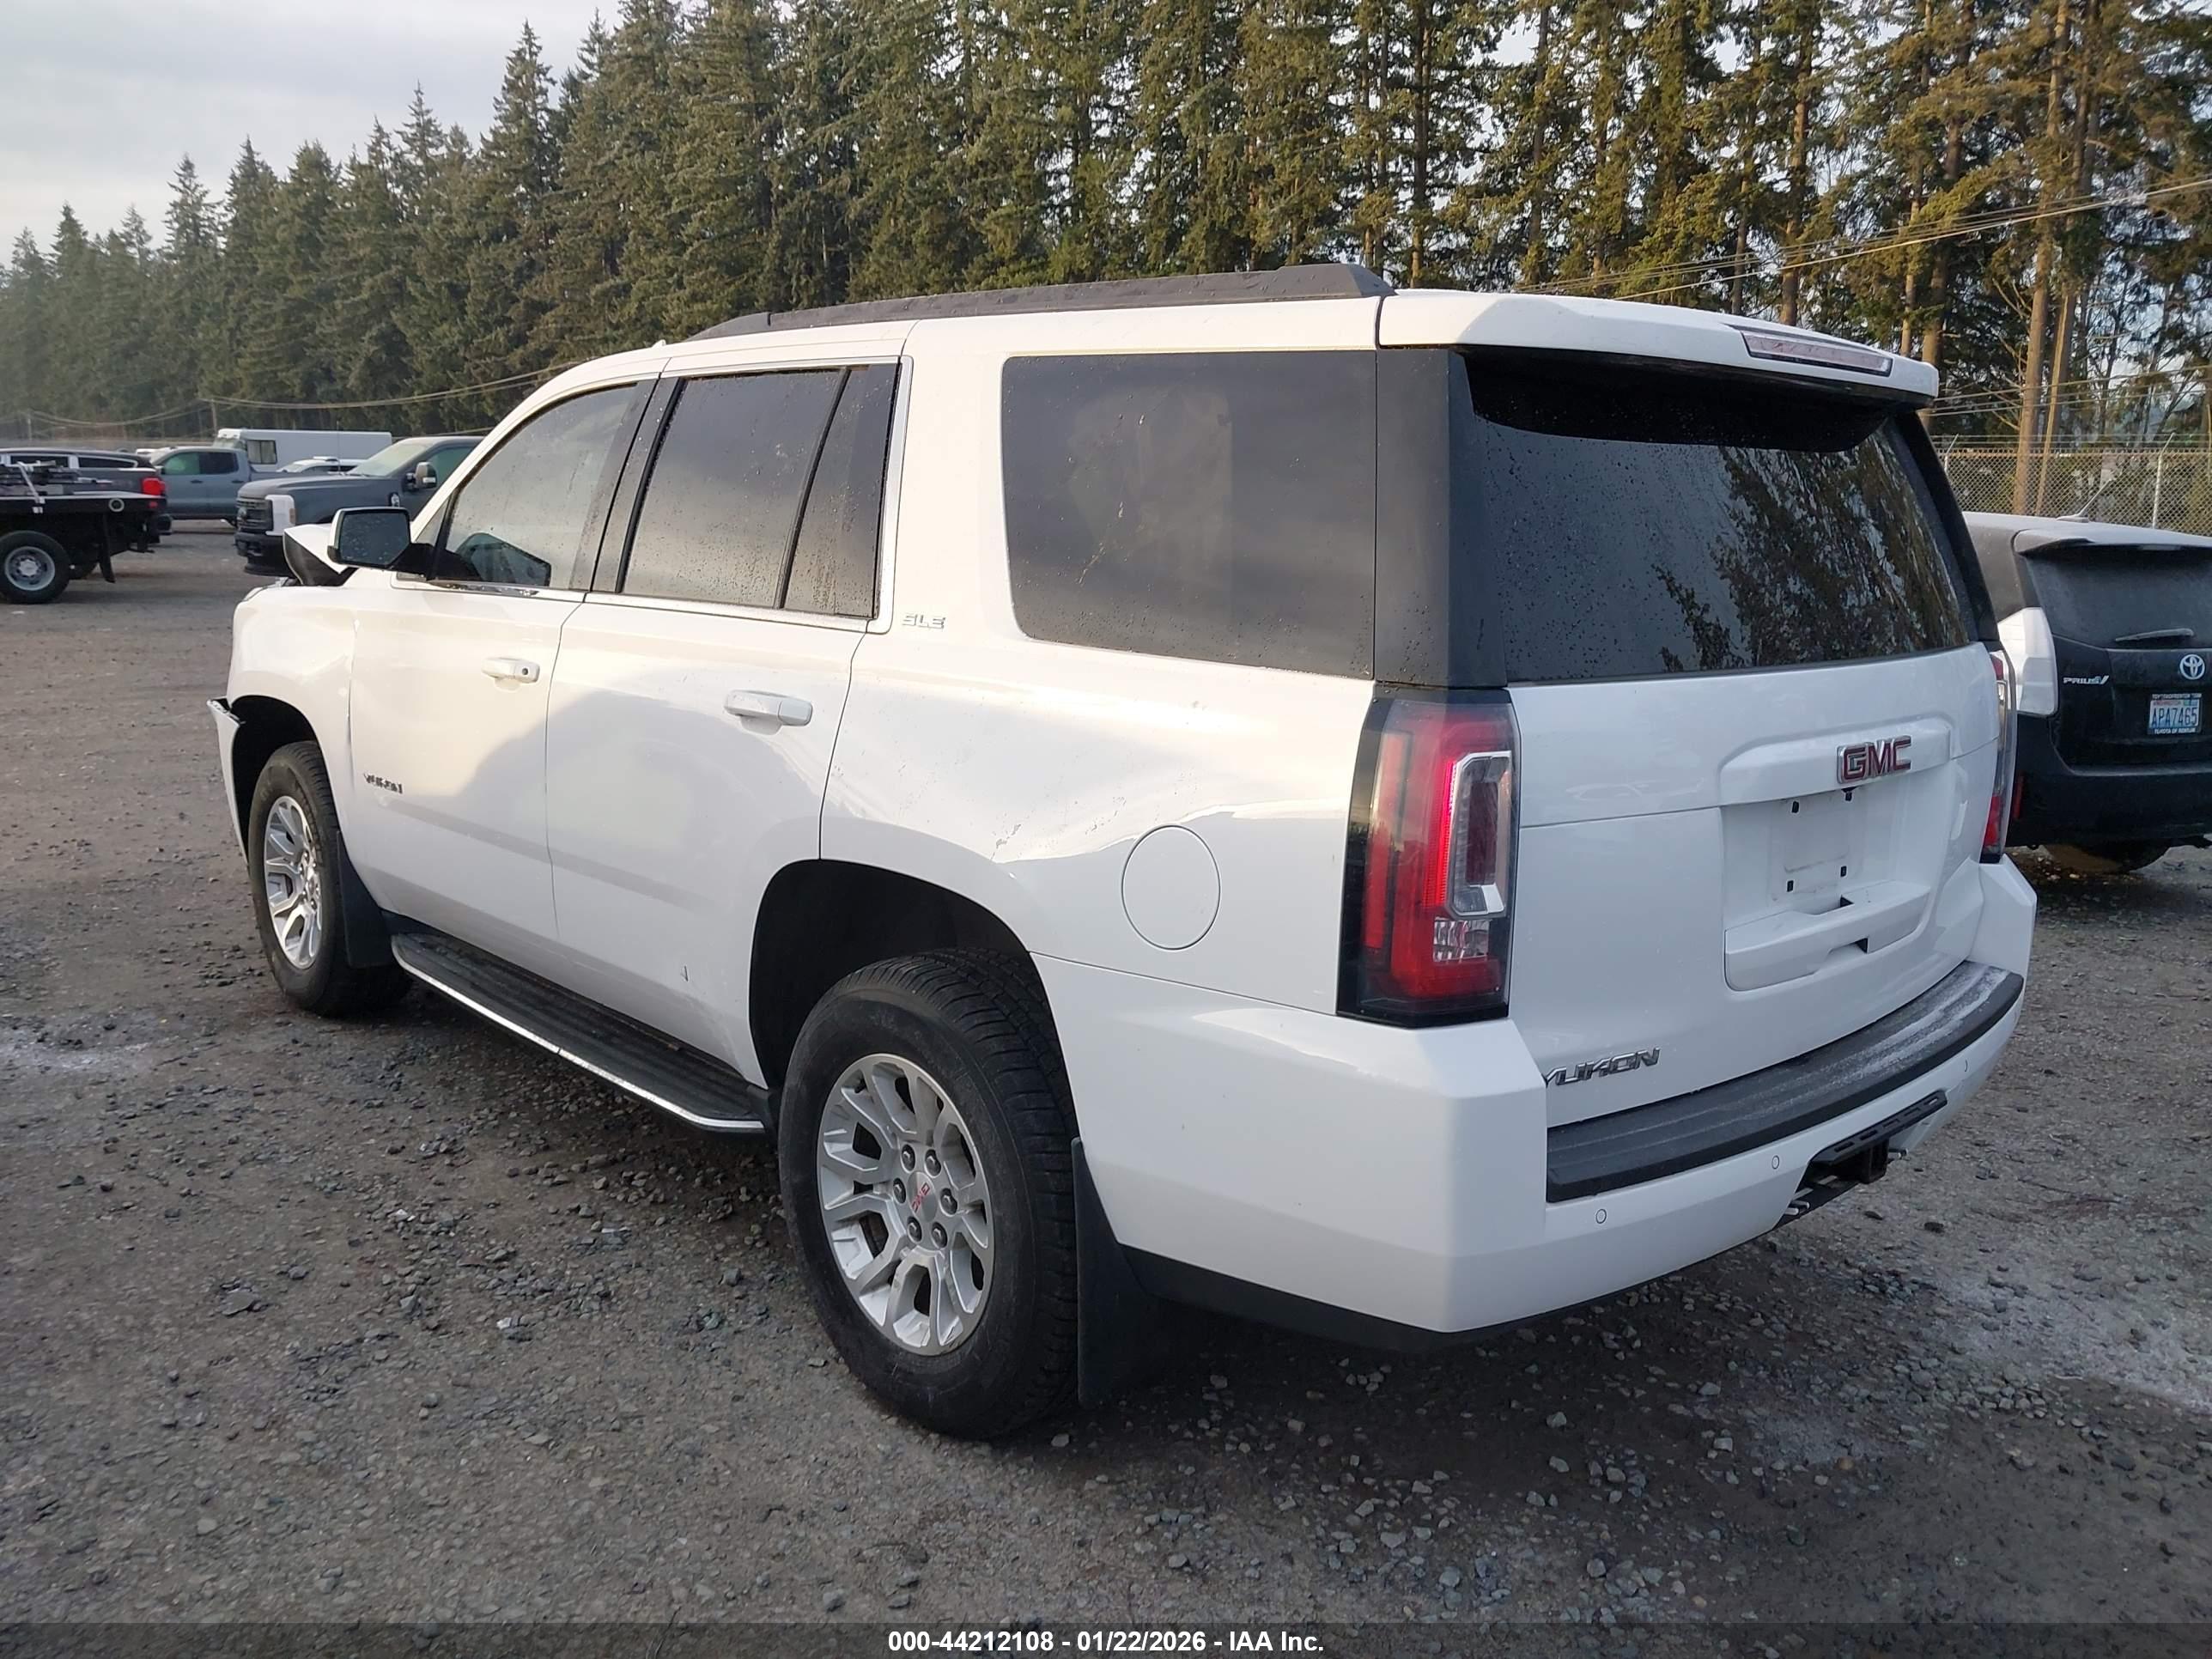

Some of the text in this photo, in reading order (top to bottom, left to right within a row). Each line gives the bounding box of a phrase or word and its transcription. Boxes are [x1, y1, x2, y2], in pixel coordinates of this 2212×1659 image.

[2151, 707, 2198, 728] APA7465
[1837, 735, 1912, 784] GMC
[1541, 1047, 1661, 1088] YUKON
